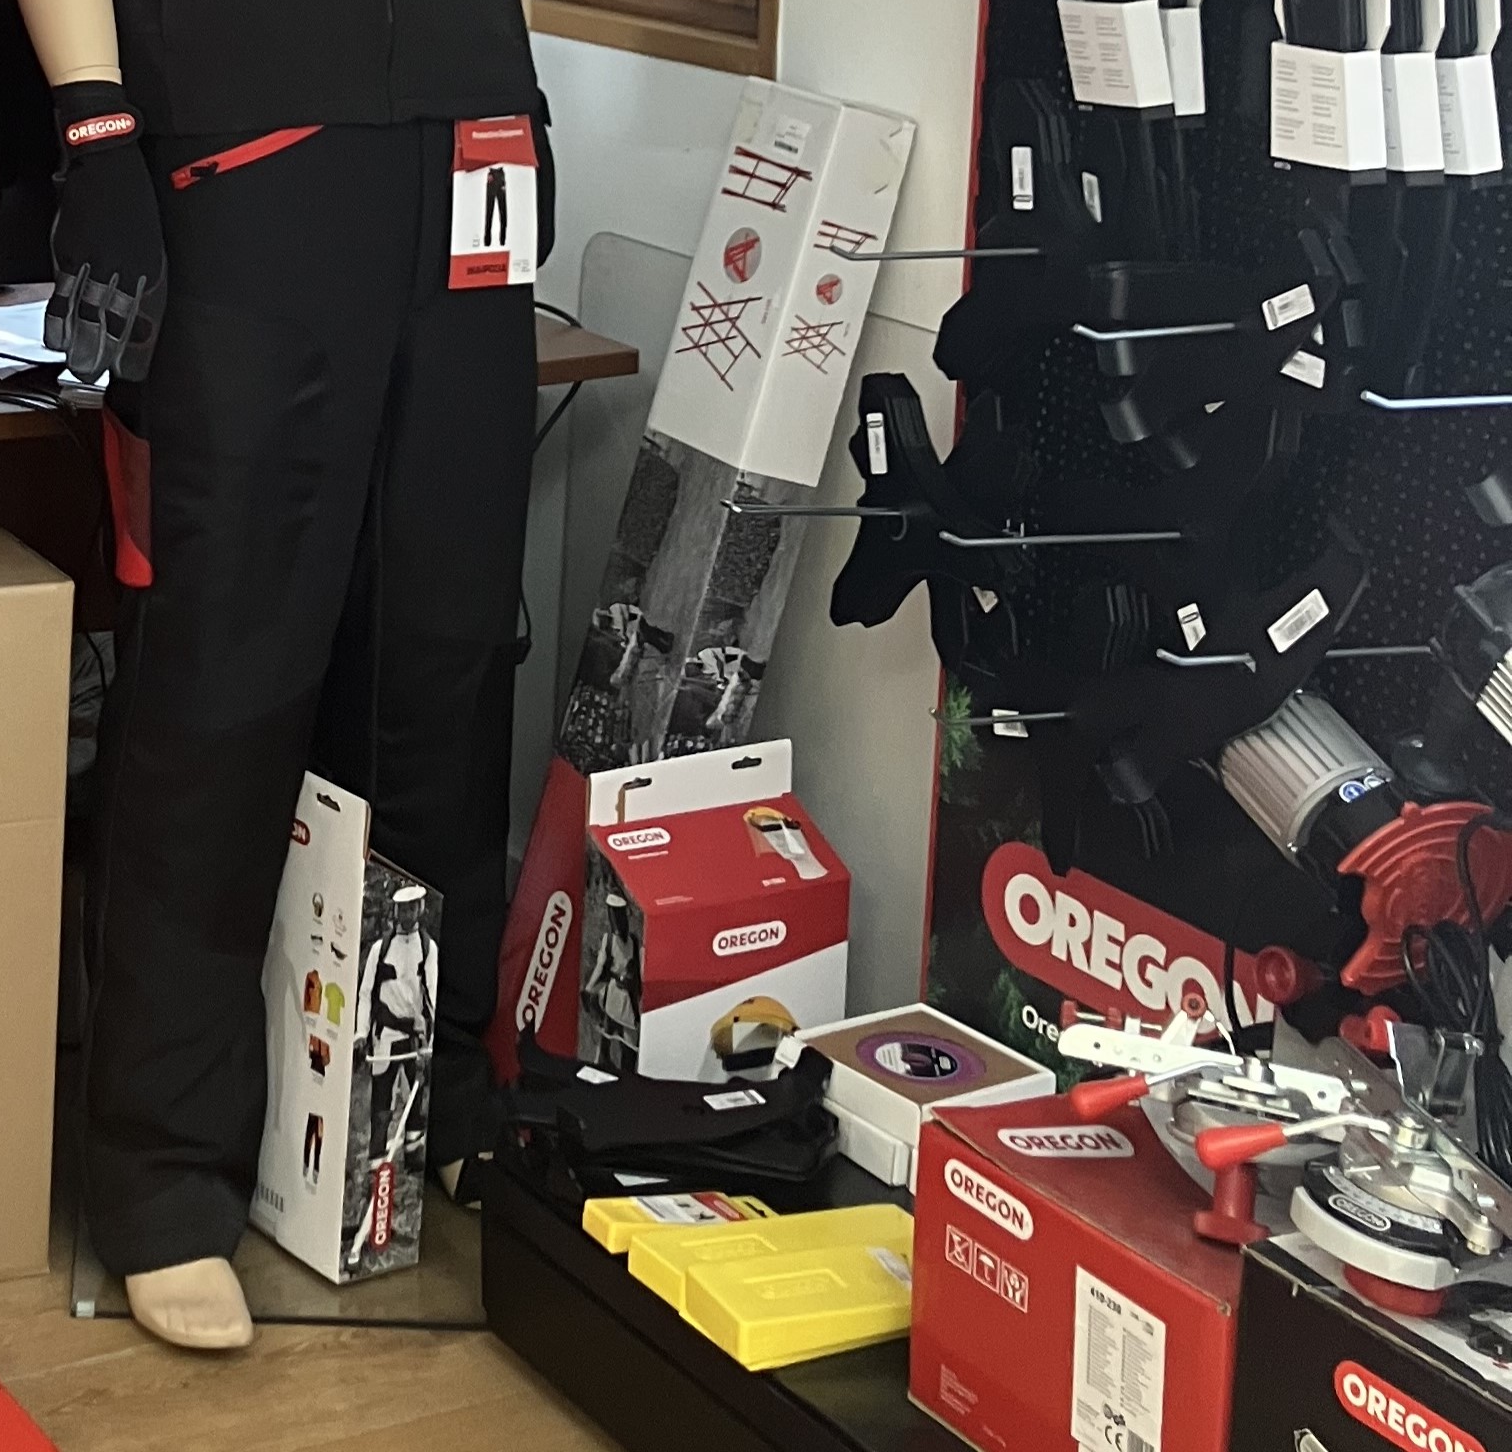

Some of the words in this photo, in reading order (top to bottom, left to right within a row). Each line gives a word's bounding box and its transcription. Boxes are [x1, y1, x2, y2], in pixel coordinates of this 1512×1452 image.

[69, 118, 126, 141] OREGON
[613, 832, 664, 847] OREGON
[718, 927, 779, 949] OREGON
[522, 904, 566, 1024] OREGON
[1022, 1005, 1060, 1041] Ore
[1009, 1131, 1121, 1150] OREGON
[375, 1169, 391, 1245] OREGON
[950, 1168, 1025, 1232] OREGON
